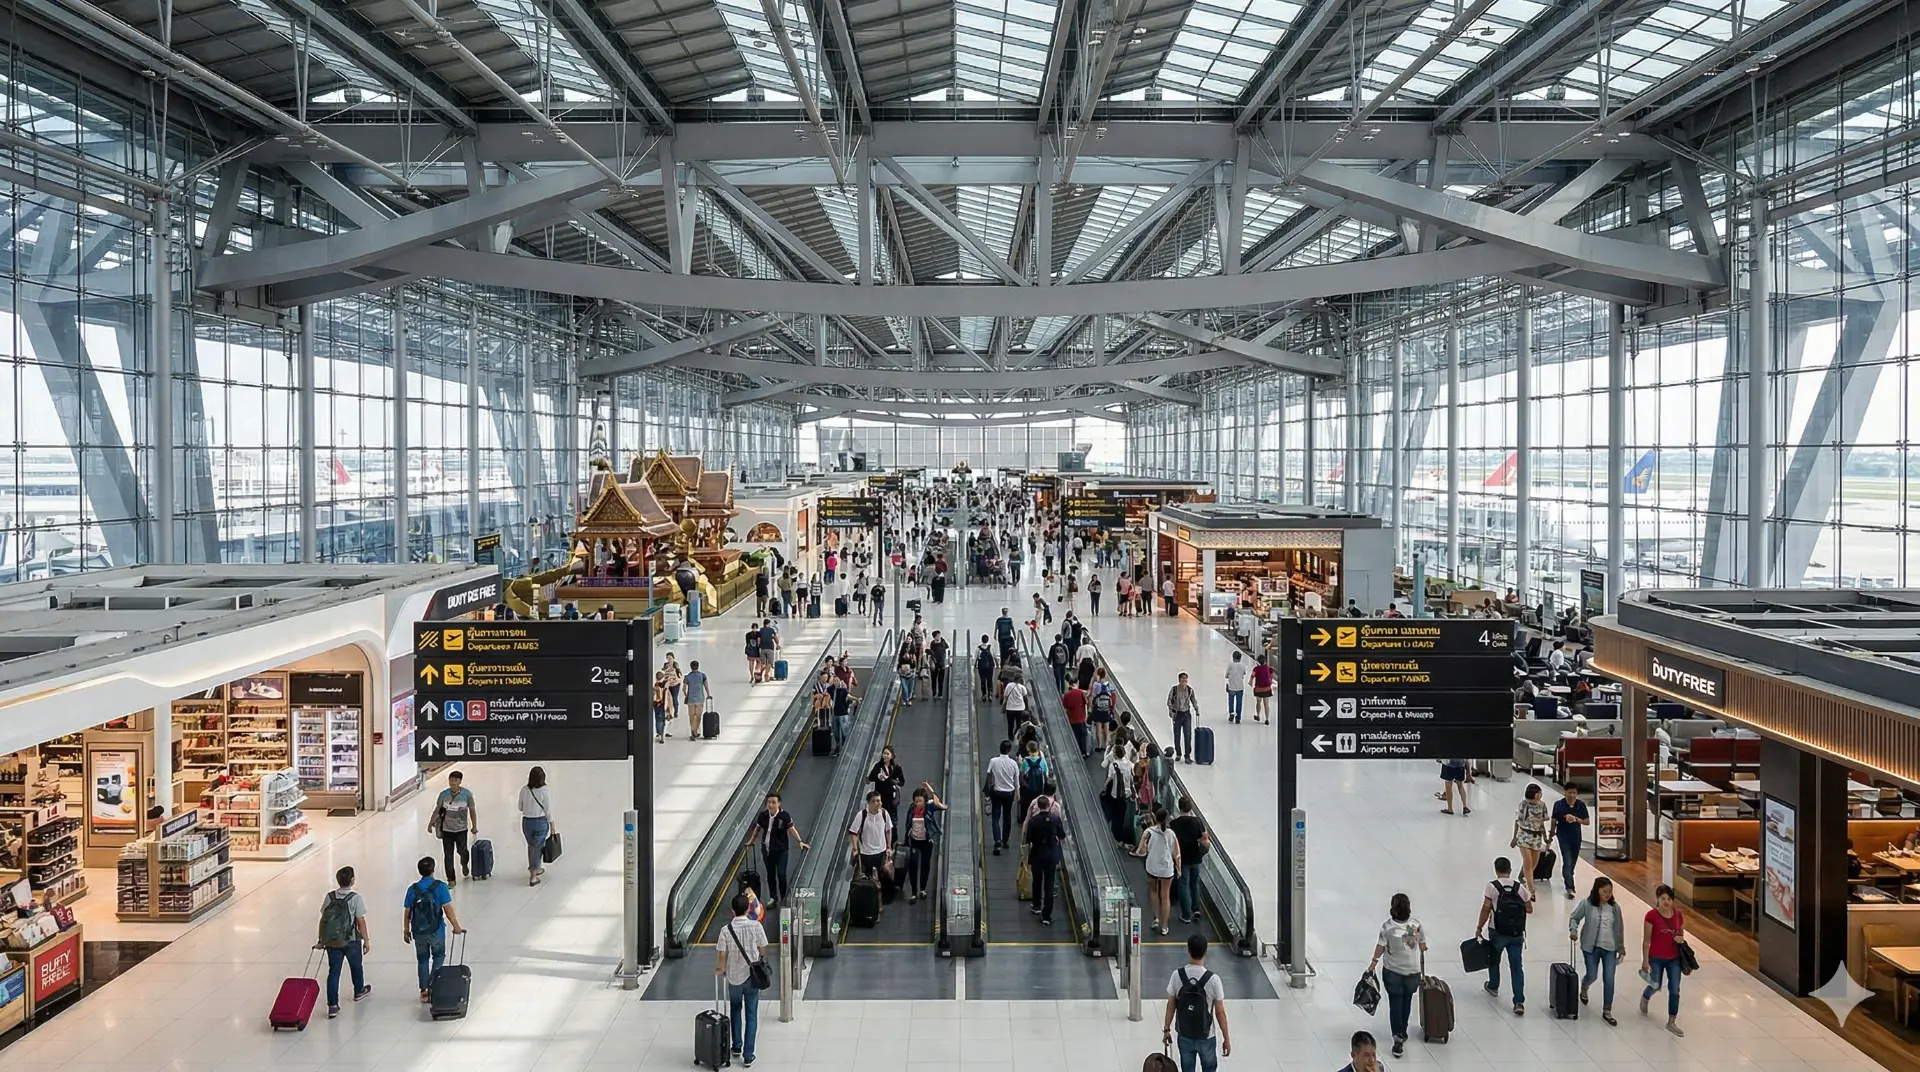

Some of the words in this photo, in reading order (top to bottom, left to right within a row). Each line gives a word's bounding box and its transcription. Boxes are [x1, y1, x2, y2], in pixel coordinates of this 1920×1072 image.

[1479, 630, 1490, 646] 4
[591, 666, 602, 683] 2
[591, 702, 604, 719] B
[1397, 711, 1404, 719] &
[1360, 745, 1387, 755] Airport
